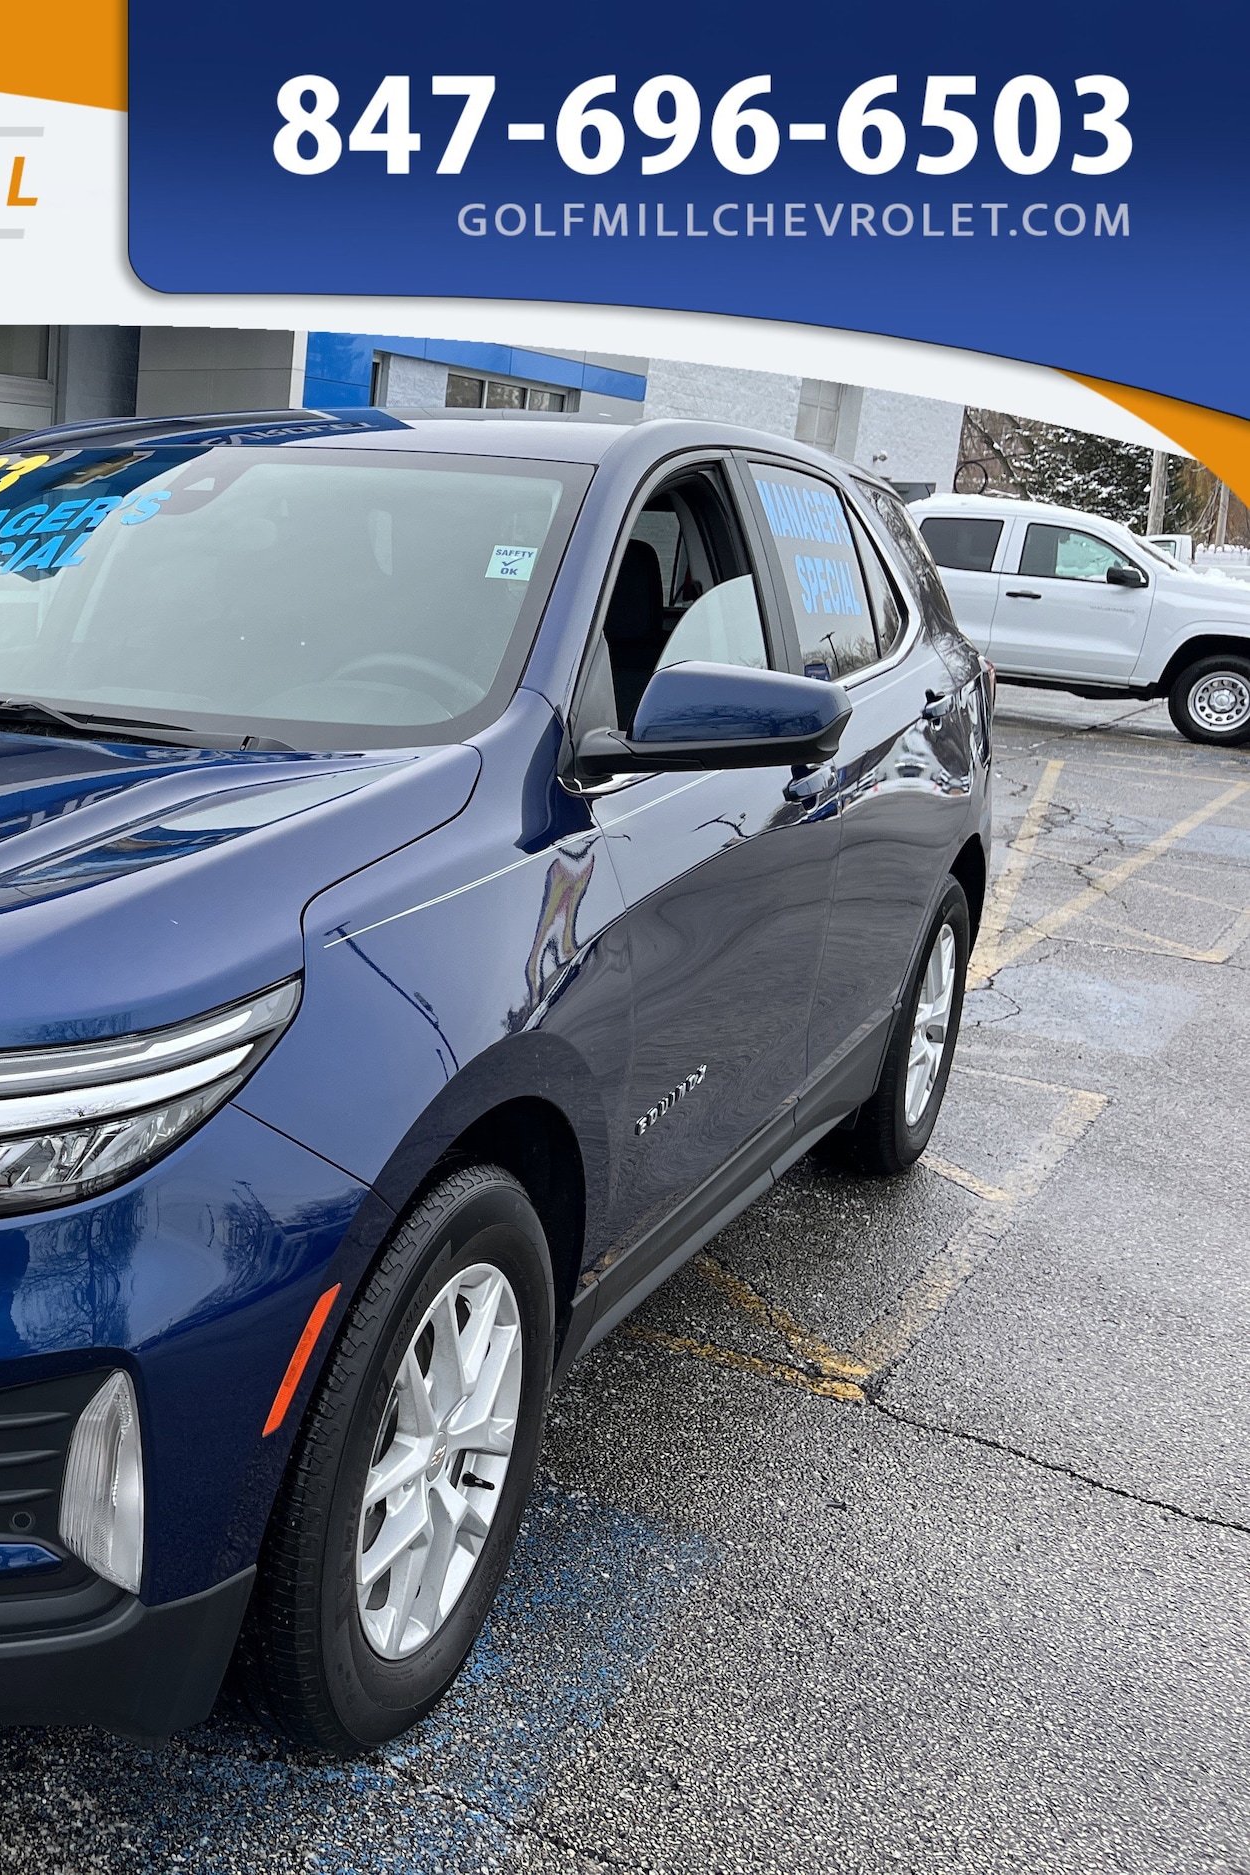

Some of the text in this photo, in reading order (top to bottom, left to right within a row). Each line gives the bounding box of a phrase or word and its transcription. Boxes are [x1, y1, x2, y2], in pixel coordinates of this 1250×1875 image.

[755, 479, 853, 547] MANAGER'S
[495, 549, 534, 558] SAFETY
[500, 567, 519, 575] OK
[795, 554, 862, 615] SPECIAL
[634, 1064, 707, 1136] EQUINOX
